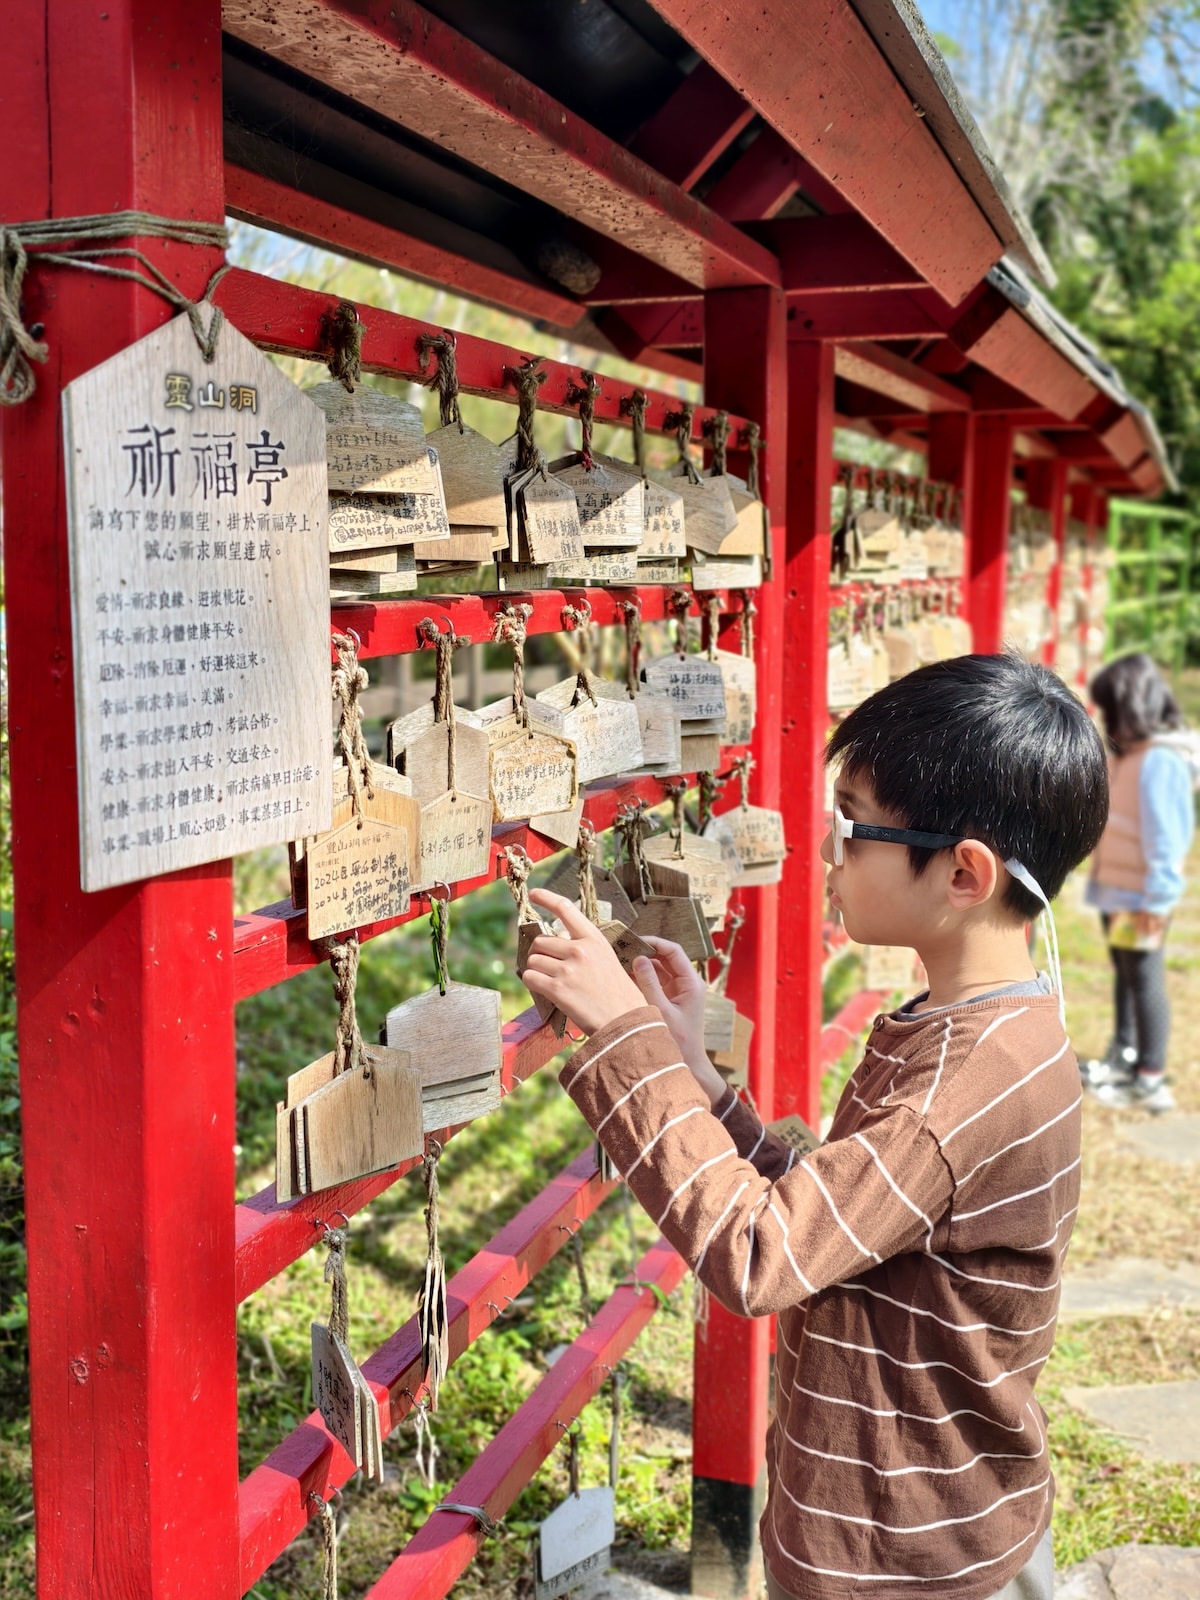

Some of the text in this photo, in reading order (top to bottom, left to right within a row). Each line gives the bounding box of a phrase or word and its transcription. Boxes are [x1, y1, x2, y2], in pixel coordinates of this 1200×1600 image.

[164, 375, 259, 414] 靈山洞
[122, 422, 289, 507] 祈福亭
[143, 540, 281, 562] 誠心祈求願望達成。
[97, 620, 244, 647] 平安-祈求身體健康平安。
